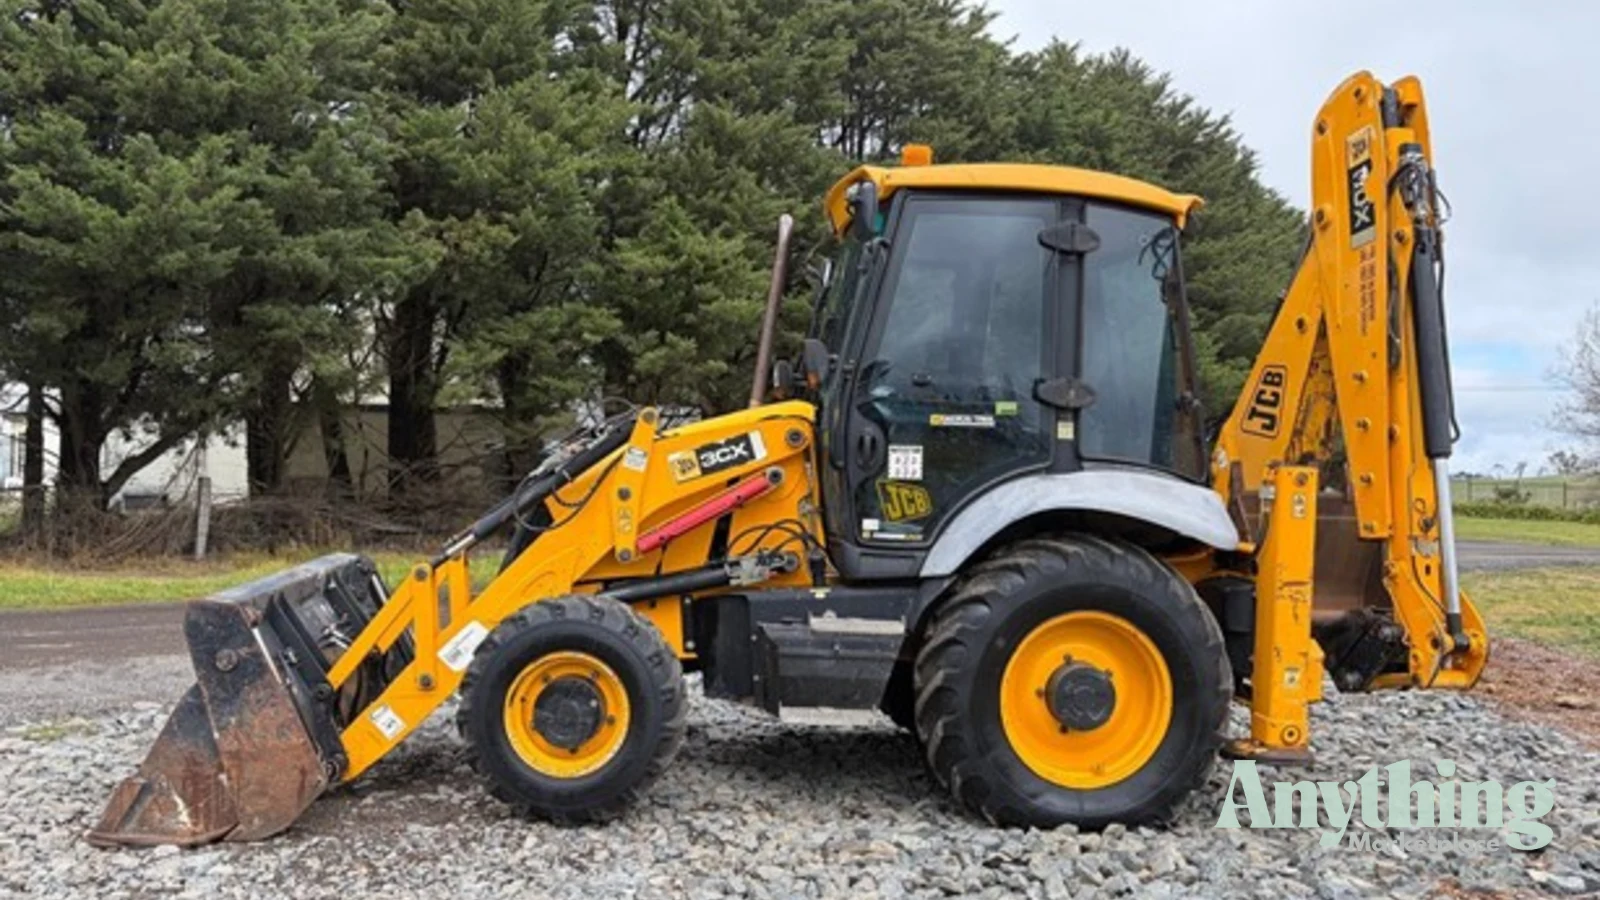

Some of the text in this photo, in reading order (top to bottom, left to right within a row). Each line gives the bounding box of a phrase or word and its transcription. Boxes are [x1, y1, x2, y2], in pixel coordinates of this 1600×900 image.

[1248, 371, 1283, 431] JCB
[700, 442, 750, 468] 3CX
[884, 483, 929, 520] JCB
